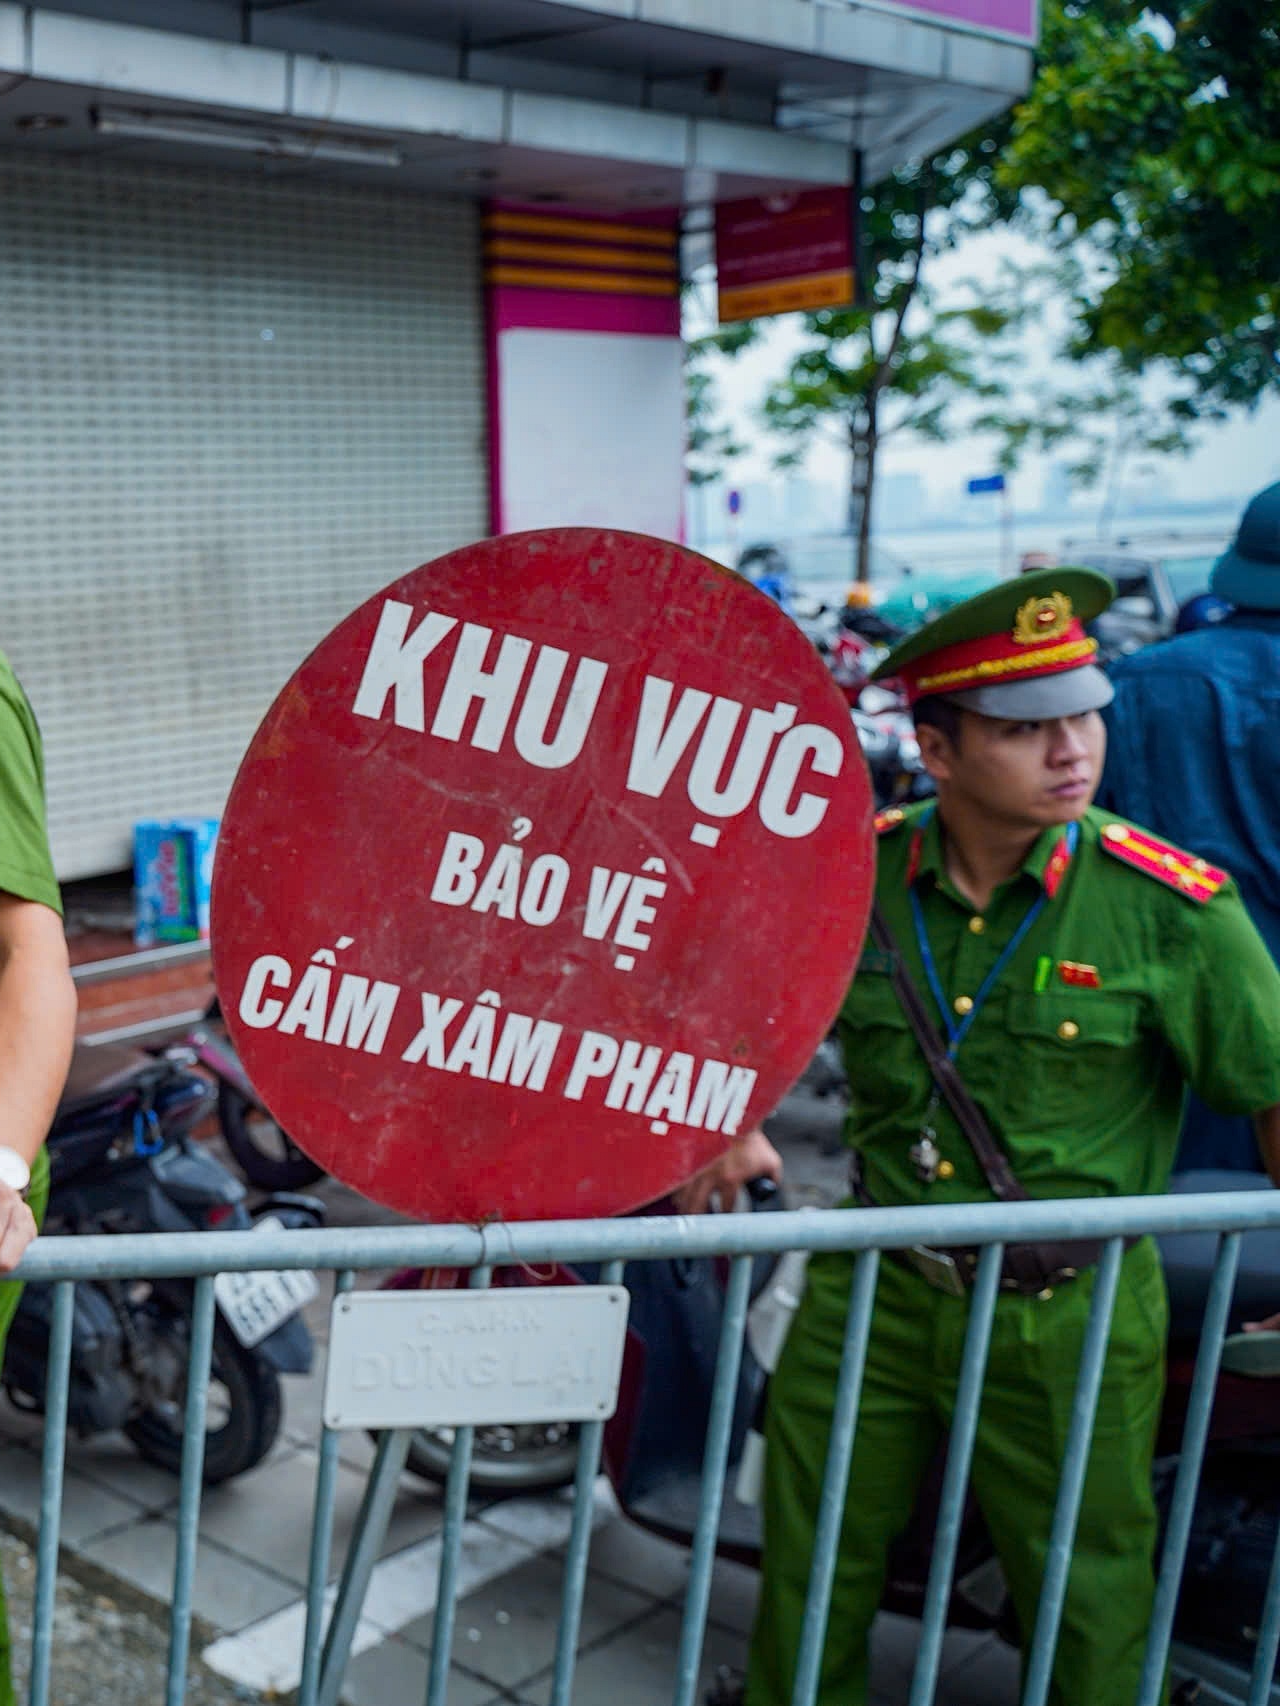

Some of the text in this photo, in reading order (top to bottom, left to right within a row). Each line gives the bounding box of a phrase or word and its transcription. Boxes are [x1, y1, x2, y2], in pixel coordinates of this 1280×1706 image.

[351, 598, 844, 848] KHU VỰC
[430, 816, 667, 972] BẢO VỆ
[239, 935, 758, 1136] CẤM XÂM PHẠM
